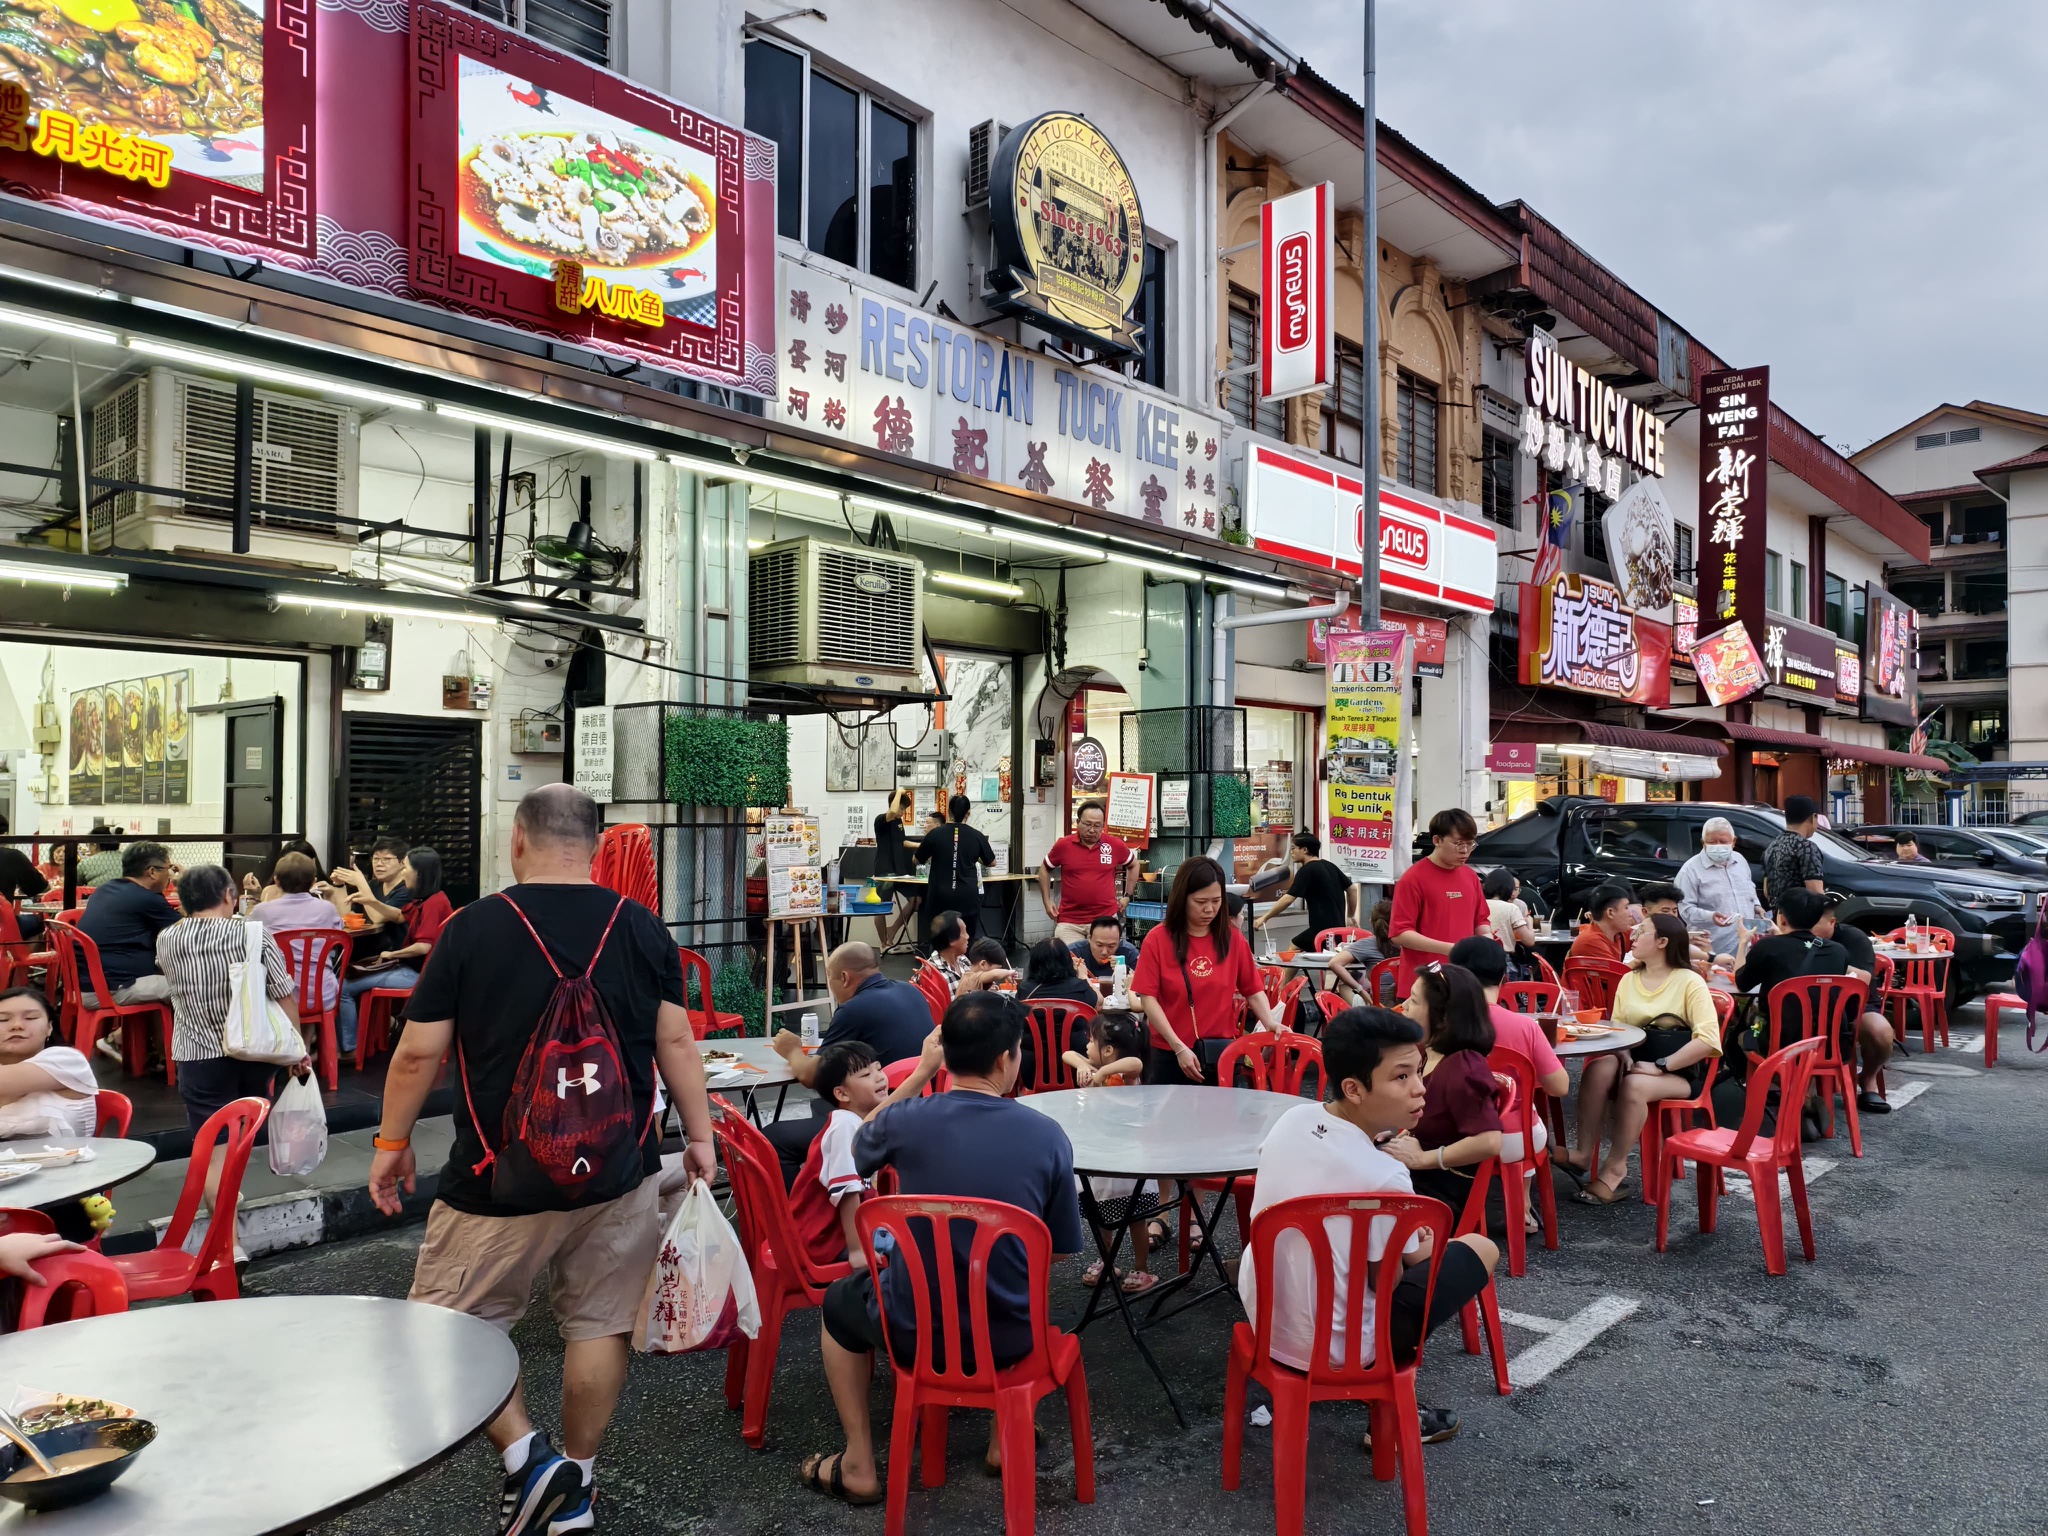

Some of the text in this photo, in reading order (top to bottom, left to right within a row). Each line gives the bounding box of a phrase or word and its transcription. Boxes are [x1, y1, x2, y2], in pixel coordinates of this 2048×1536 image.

[40, 115, 168, 182] 月光河
[1020, 123, 1121, 194] IPOH TUCK KEE
[1040, 200, 1122, 258] Since 1963
[560, 263, 580, 309] 清甜
[584, 280, 661, 322] 八爪鱼
[861, 297, 1179, 471] RESTORAN TUCK KEE
[1706, 379, 1762, 394] BISKUT DAN KEK
[1723, 375, 1743, 384] KEDAI
[1531, 337, 1665, 478] SUN TUCK KEE
[1719, 393, 1746, 408] SIN
[1707, 407, 1758, 425] WENG
[1718, 424, 1745, 439] FAI
[256, 448, 284, 459] MARK
[860, 577, 887, 590] Keruilai
[1589, 584, 1613, 603] SUN
[1334, 662, 1391, 682] TKB
[1572, 669, 1620, 691] TUCK KEE
[1332, 685, 1398, 693] tamkeris.com.my
[1350, 698, 1383, 706] Gardens
[1343, 723, 1375, 732] 双层排屋
[1496, 760, 1531, 769] foodpanda
[575, 771, 612, 783] Chili Sauce
[1351, 789, 1392, 802] bentuk
[1358, 803, 1382, 813] unik
[1242, 844, 1267, 854] pemanas
[1361, 849, 1387, 860] 2222
[1100, 856, 1112, 865] 09
